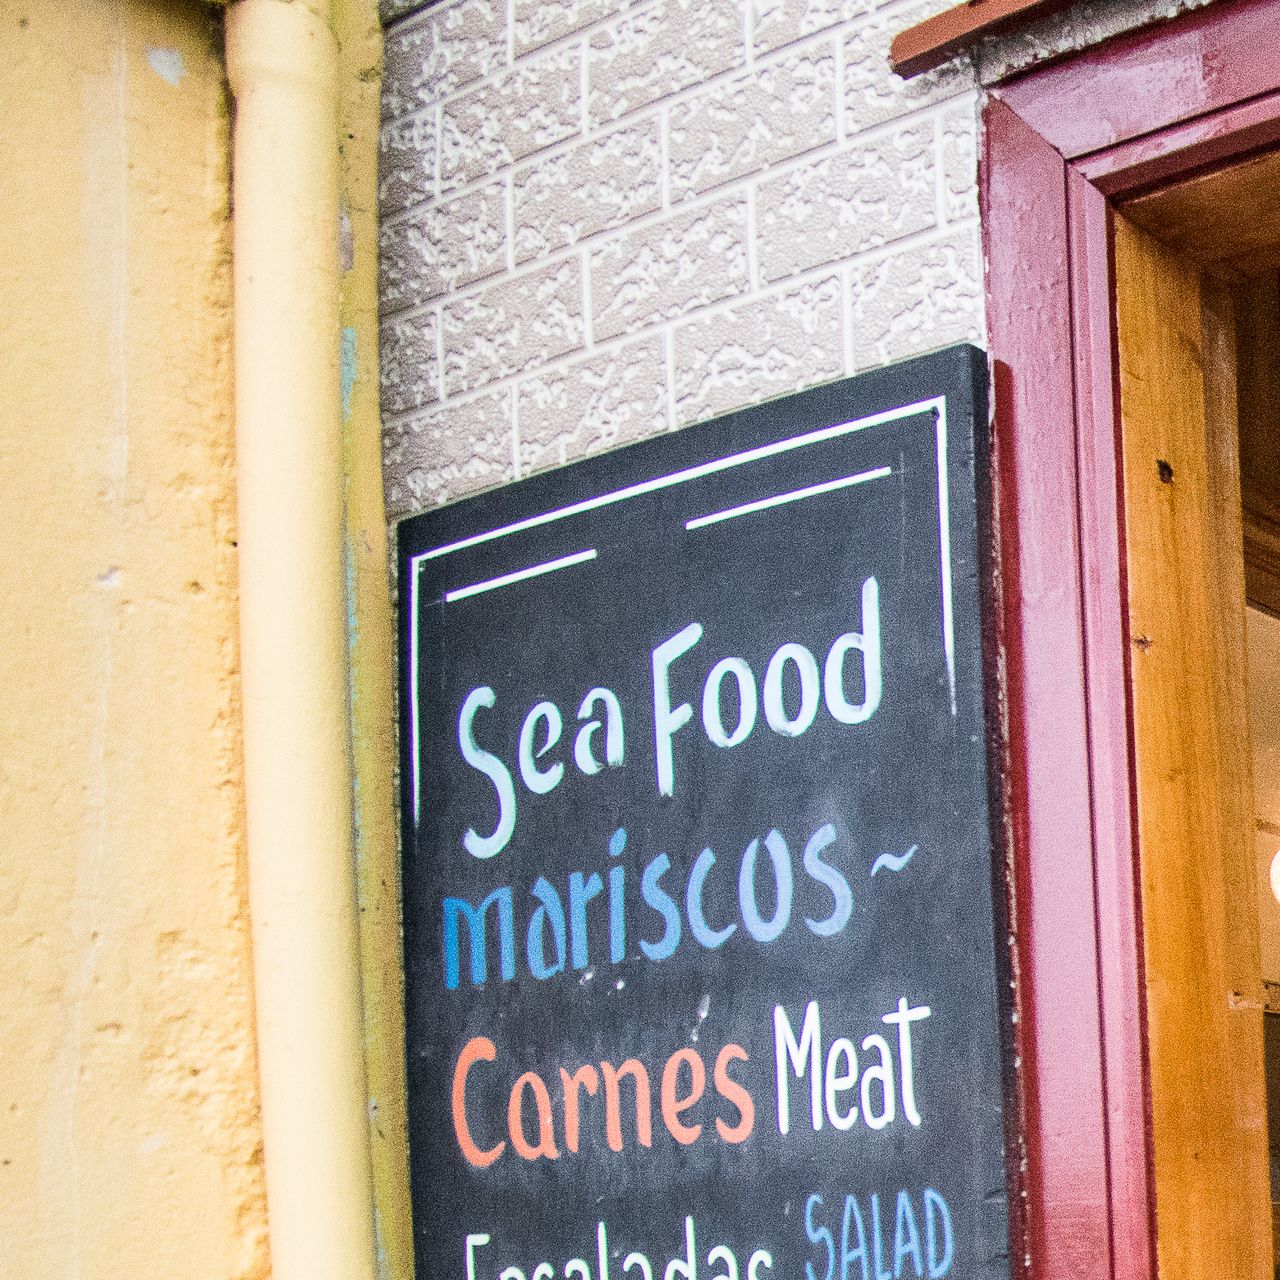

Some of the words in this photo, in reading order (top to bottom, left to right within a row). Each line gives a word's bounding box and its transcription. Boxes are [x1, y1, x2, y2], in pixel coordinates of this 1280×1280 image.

[457, 686, 625, 859] Sea
[651, 576, 882, 795] Food
[443, 821, 854, 988] mariscos
[453, 1037, 755, 1167] Carnes
[772, 997, 930, 1135] Meat
